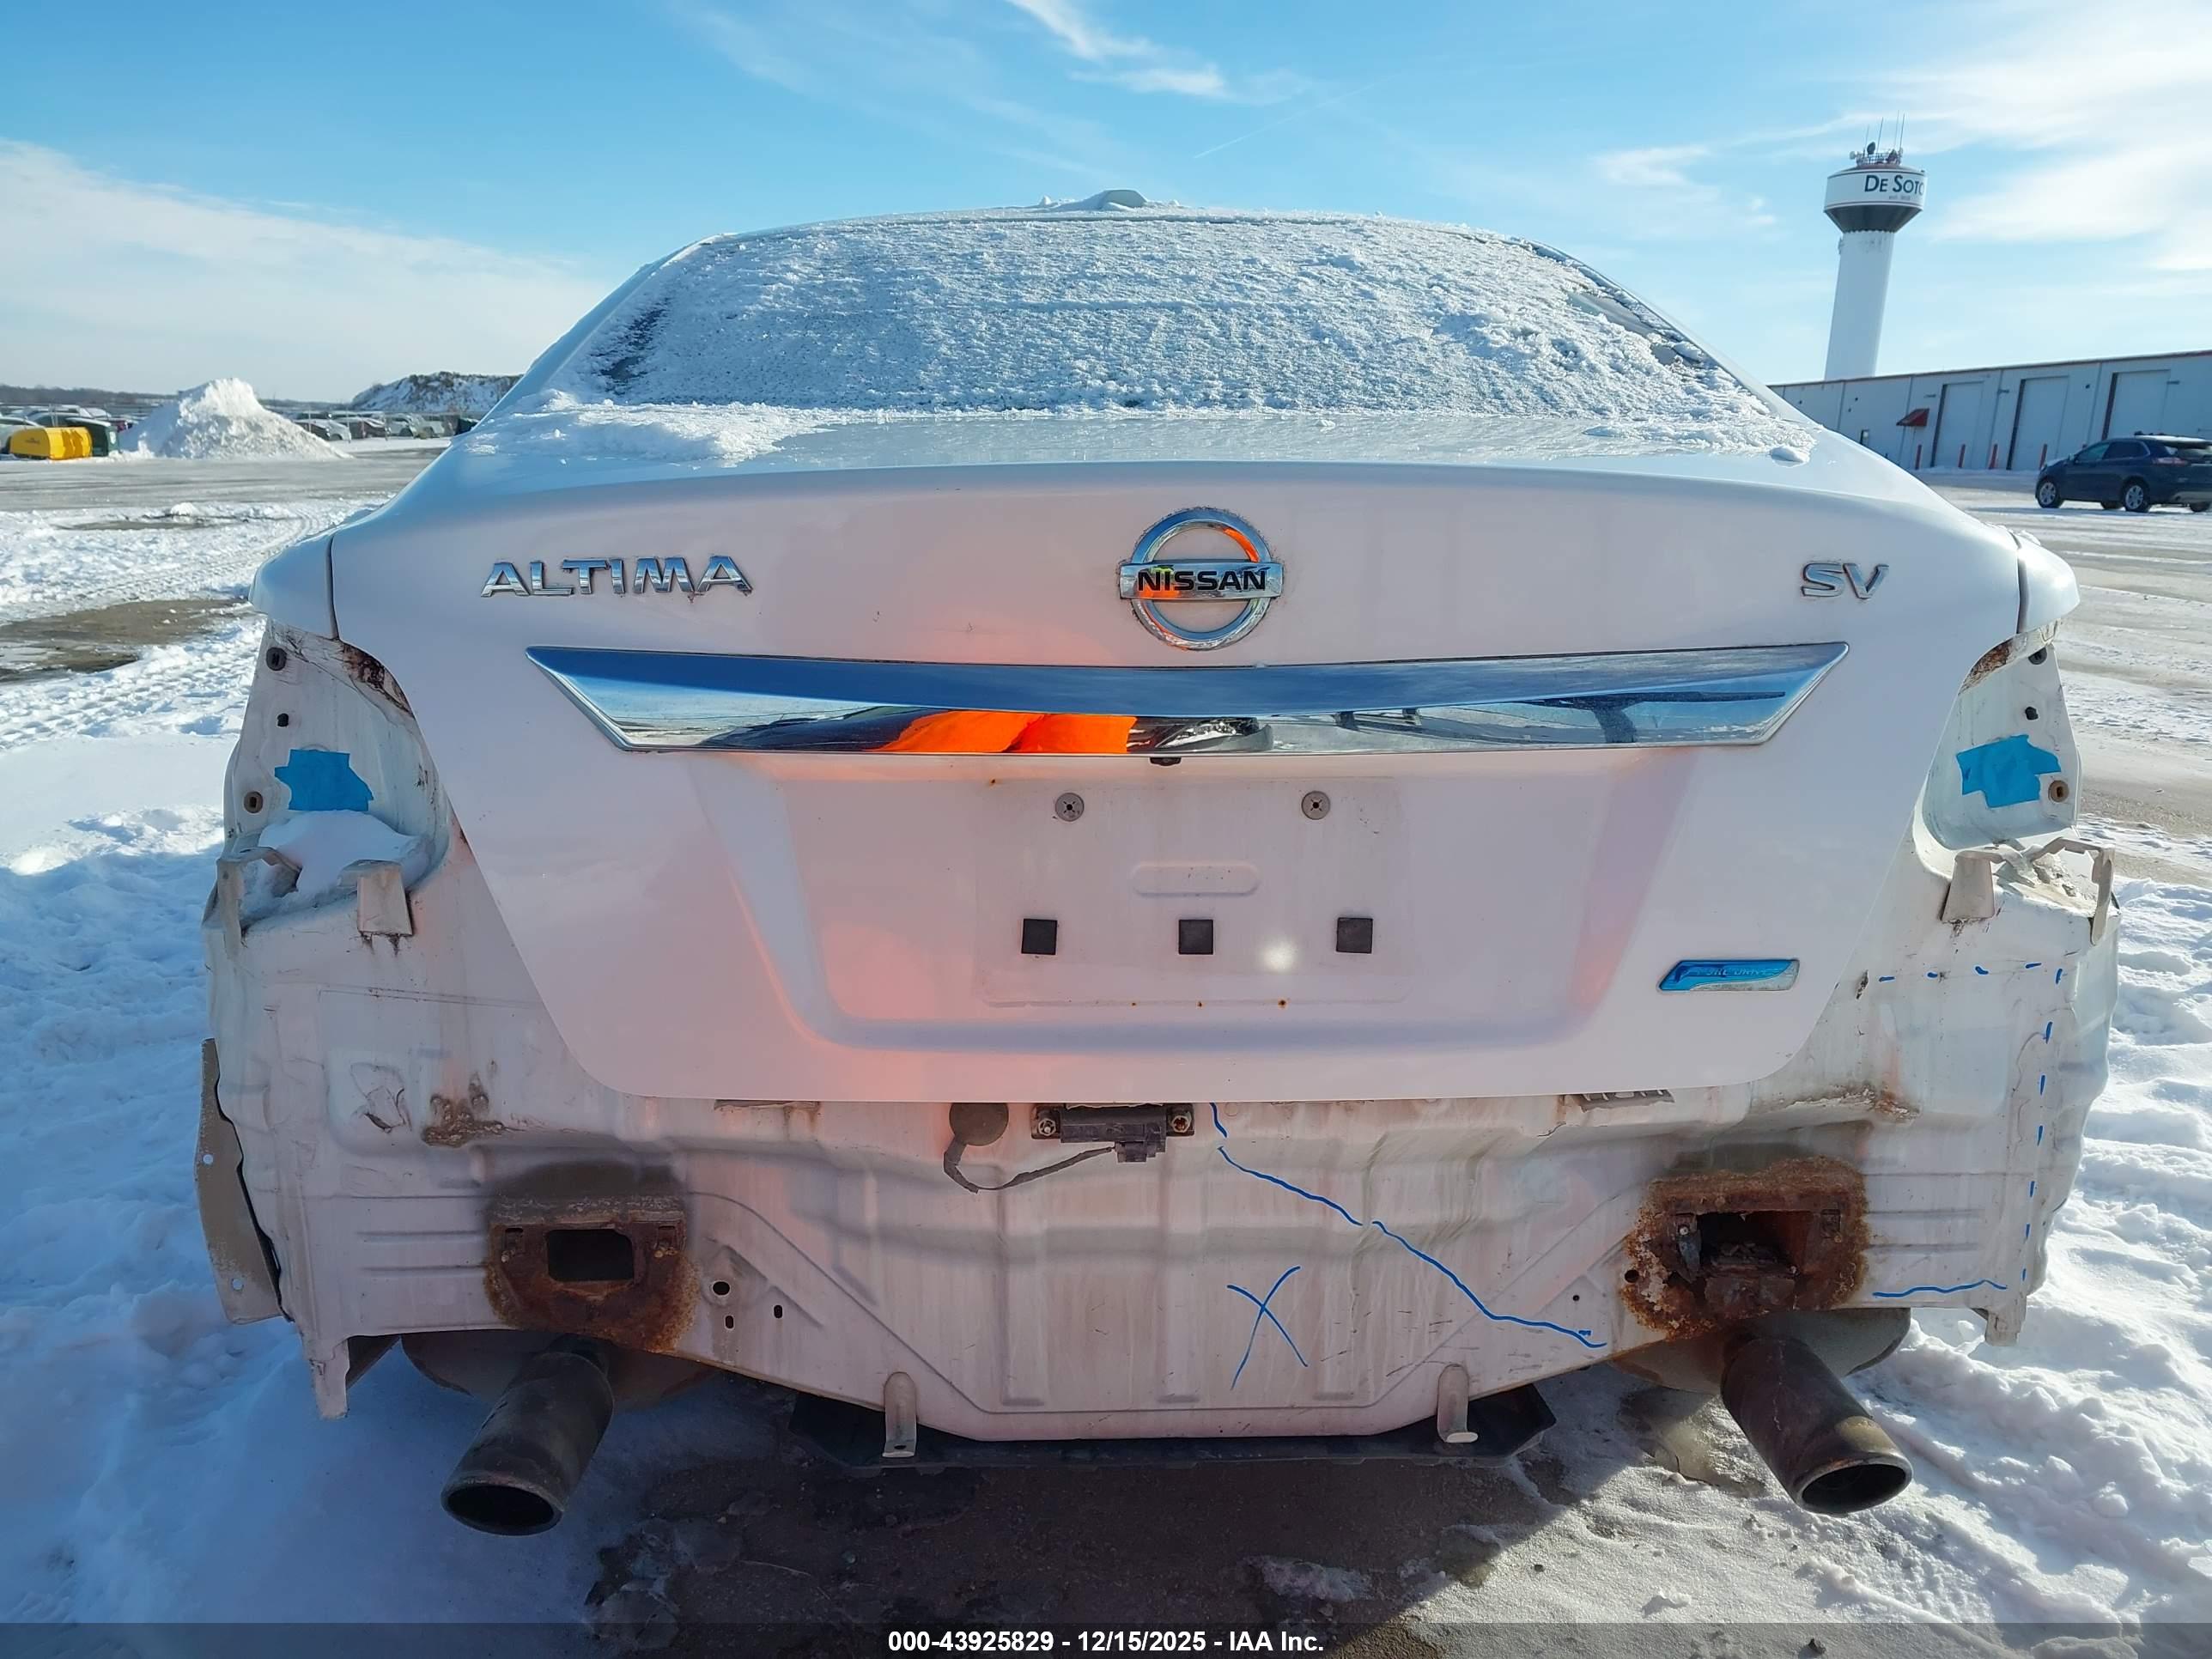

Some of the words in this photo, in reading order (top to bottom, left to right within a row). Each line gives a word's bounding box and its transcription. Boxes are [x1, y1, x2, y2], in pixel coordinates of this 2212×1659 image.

[480, 556, 753, 598] ALTIMA
[1137, 570, 1267, 592] NISSAN
[1801, 562, 1890, 599] SV
